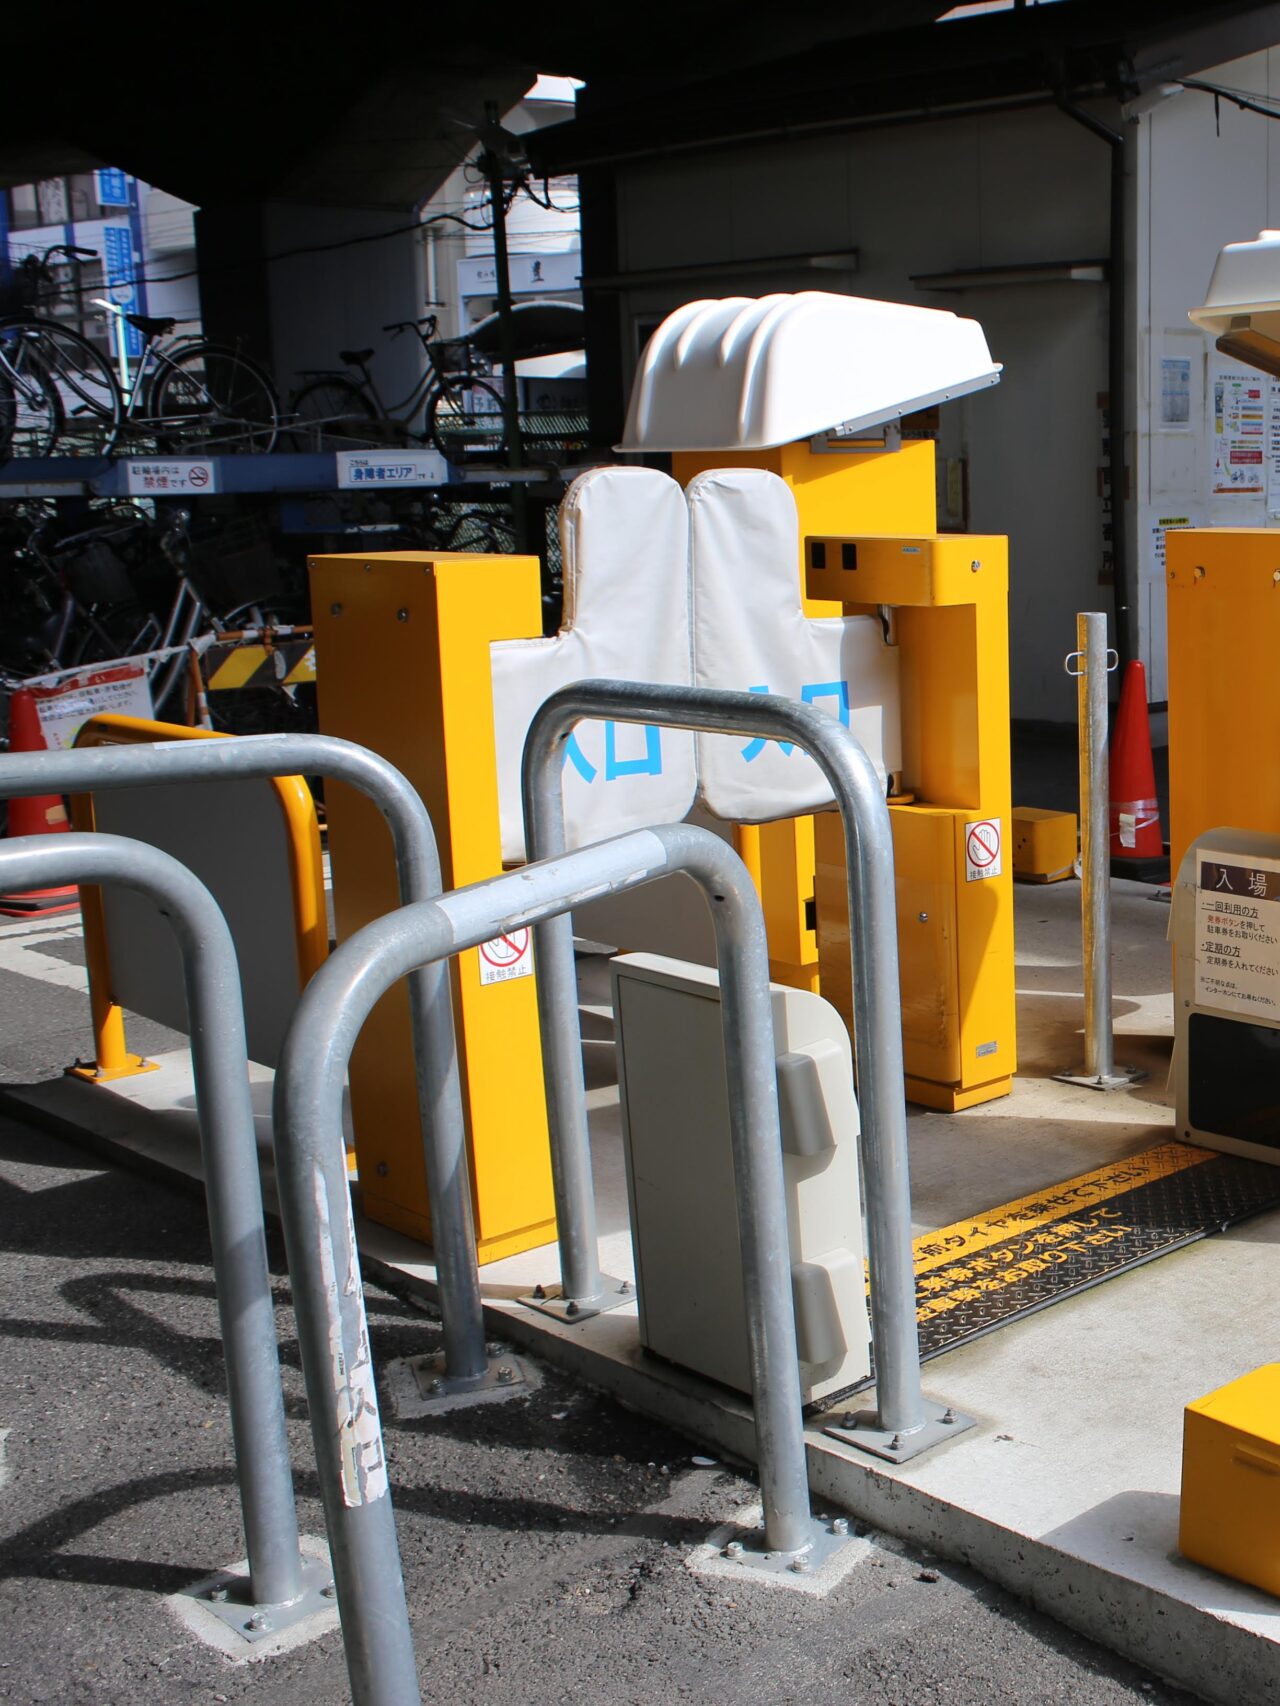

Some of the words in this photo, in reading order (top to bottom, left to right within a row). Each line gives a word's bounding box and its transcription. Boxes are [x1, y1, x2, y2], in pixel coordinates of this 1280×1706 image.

[142, 475, 188, 489] 禁煙です
[352, 467, 413, 482] 身障者エリア
[969, 866, 998, 880] 接触禁止
[1215, 867, 1268, 897] 入場
[1207, 914, 1266, 932] 発券ボタンを押して
[1207, 924, 1278, 944] 駐車券をお取りください
[486, 964, 528, 982] 接触禁止
[1206, 956, 1279, 976] 定期券を入れてください
[912, 1165, 1150, 1263] 前タイヤを乗せて下さい
[915, 1207, 1122, 1298] 発券ボタンを押して
